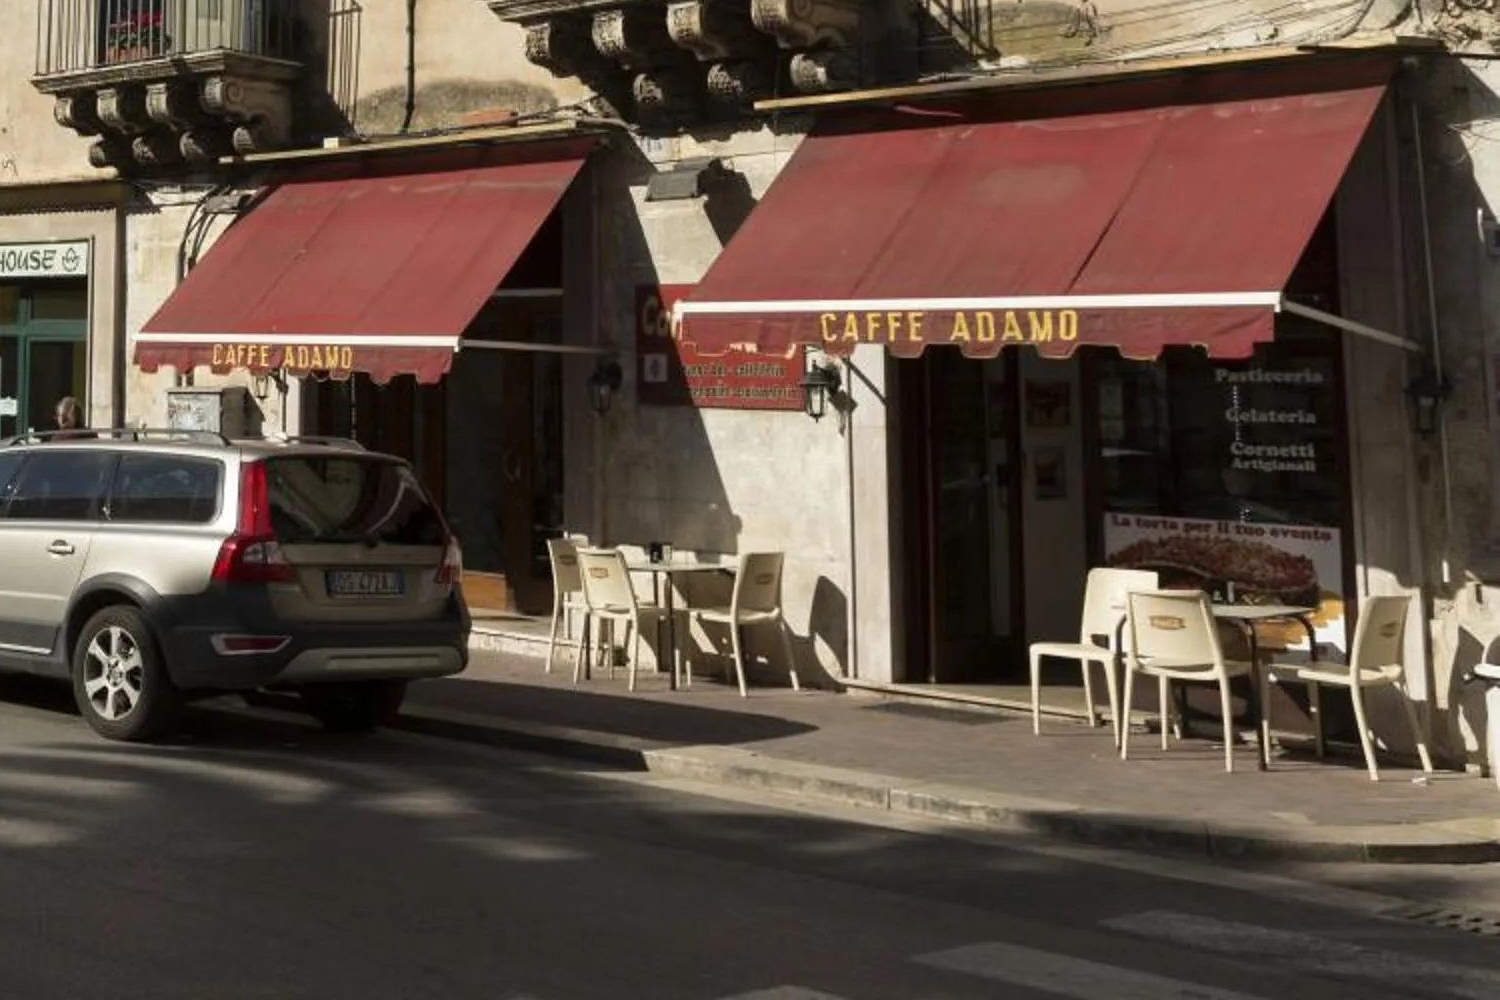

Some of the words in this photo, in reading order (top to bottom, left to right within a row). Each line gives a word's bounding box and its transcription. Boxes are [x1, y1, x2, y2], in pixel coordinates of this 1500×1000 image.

[818, 311, 924, 343] CAFFE
[949, 309, 1079, 343] ADAMO
[211, 343, 269, 367] CAFFE
[283, 344, 353, 369] ADAMO
[1214, 367, 1323, 384] Pasticceria
[1224, 407, 1316, 424] Gelateria
[1229, 441, 1315, 458] Cornetti
[1111, 514, 1130, 527] La
[1136, 516, 1178, 530] torta
[1184, 520, 1212, 534] per
[1216, 518, 1229, 534] il
[1269, 527, 1332, 542] evento
